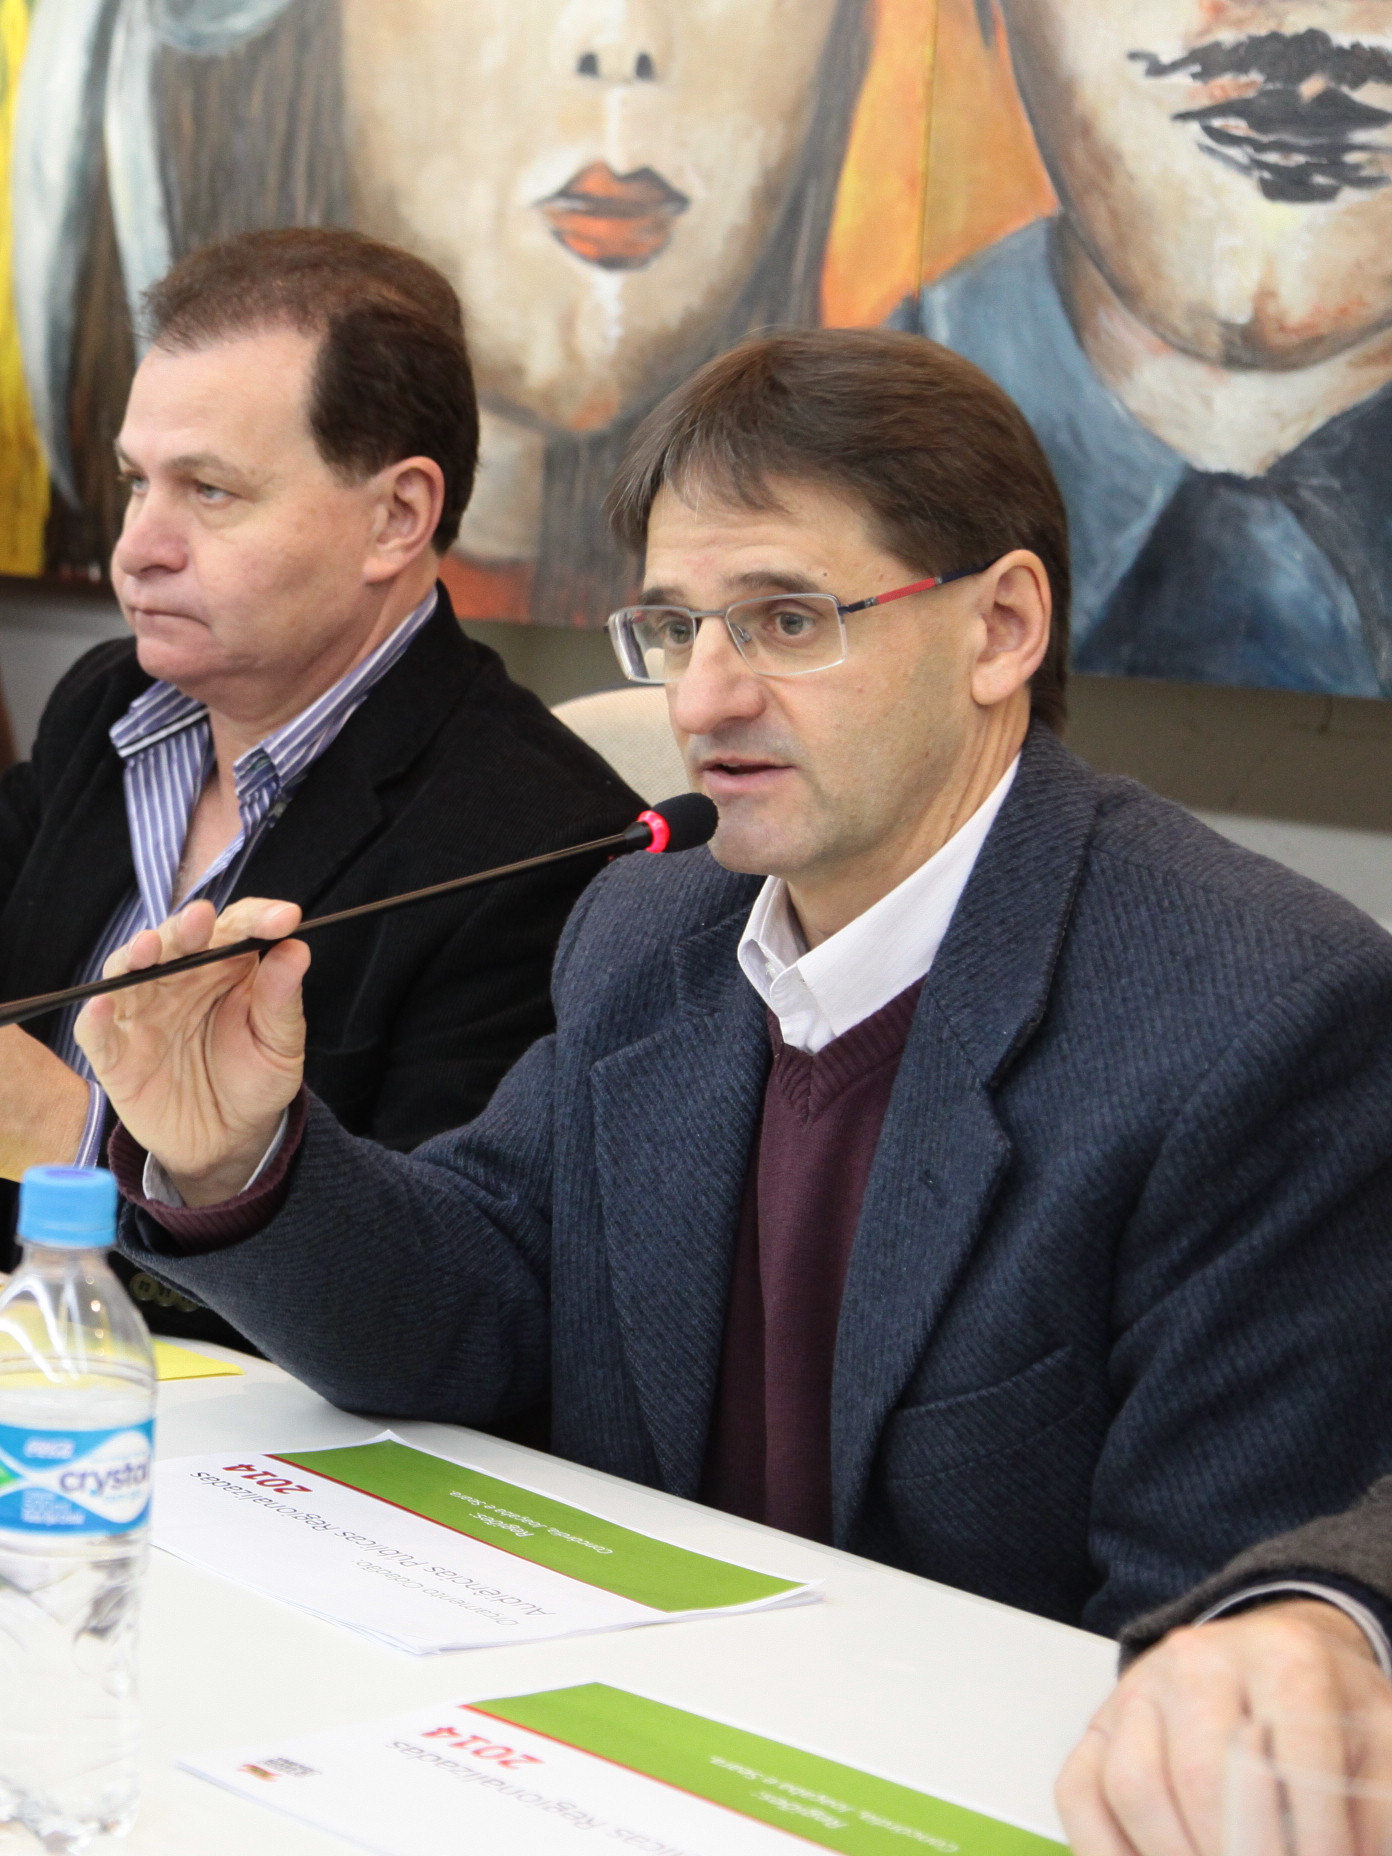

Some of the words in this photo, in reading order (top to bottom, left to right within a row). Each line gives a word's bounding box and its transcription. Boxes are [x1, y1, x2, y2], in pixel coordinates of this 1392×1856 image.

[189, 1471, 336, 1533] Regionalizadas
[222, 1462, 313, 1495] 2014
[334, 1529, 420, 1568] Públicas
[424, 1566, 557, 1617] Audiências
[420, 1725, 545, 1770] 2014
[385, 1739, 606, 1831] Regionalizadas
